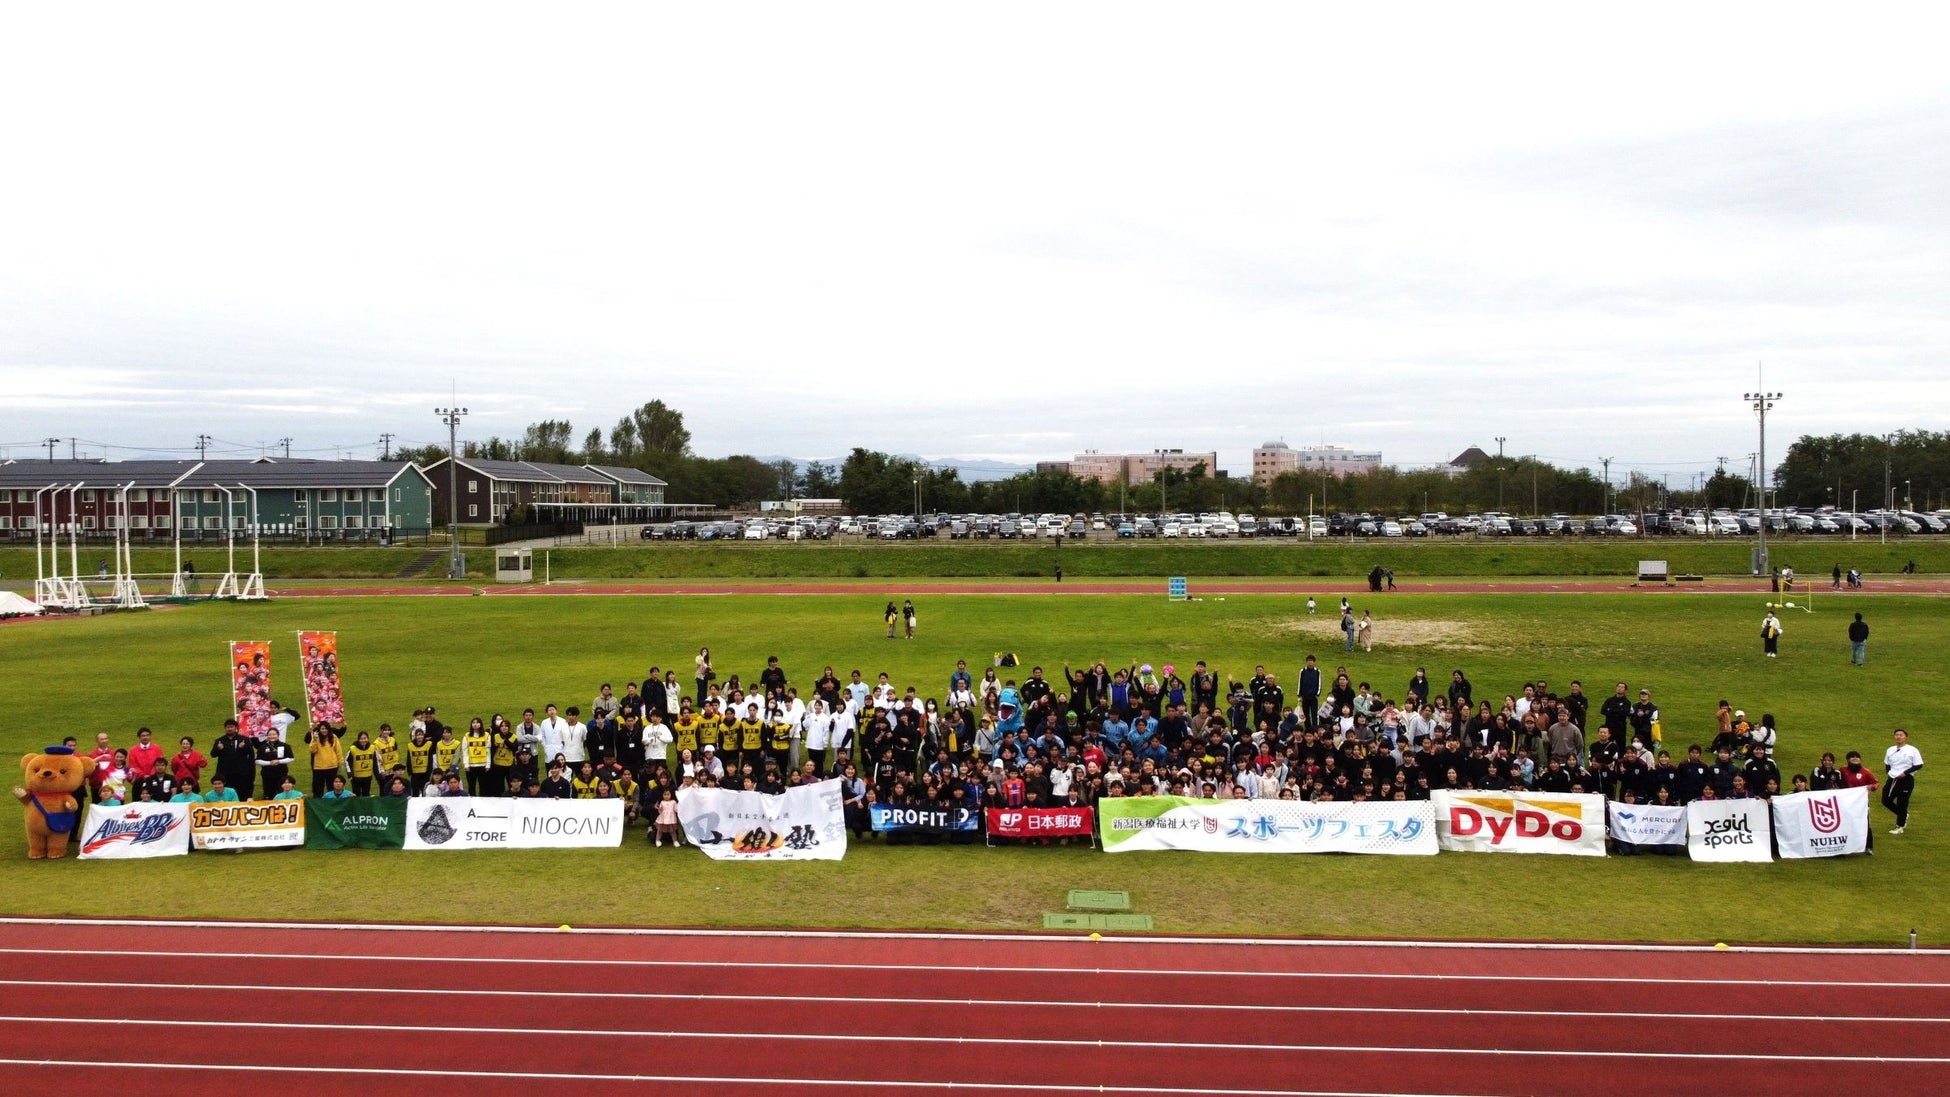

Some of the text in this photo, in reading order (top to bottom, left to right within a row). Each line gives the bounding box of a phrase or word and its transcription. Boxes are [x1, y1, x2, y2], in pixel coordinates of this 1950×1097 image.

[342, 815, 388, 826] ALPRON
[522, 816, 610, 835] NIOCAN
[1028, 815, 1083, 830] 日本郵政
[1112, 816, 1200, 831] 新潟医療福祉大学
[1226, 815, 1424, 842] スポーツフェスタ
[1450, 807, 1583, 845] DyDo
[83, 812, 174, 847] Albirex BB
[465, 831, 507, 842] STORE
[1704, 831, 1753, 849] sports
[1810, 836, 1848, 847] NUHW
